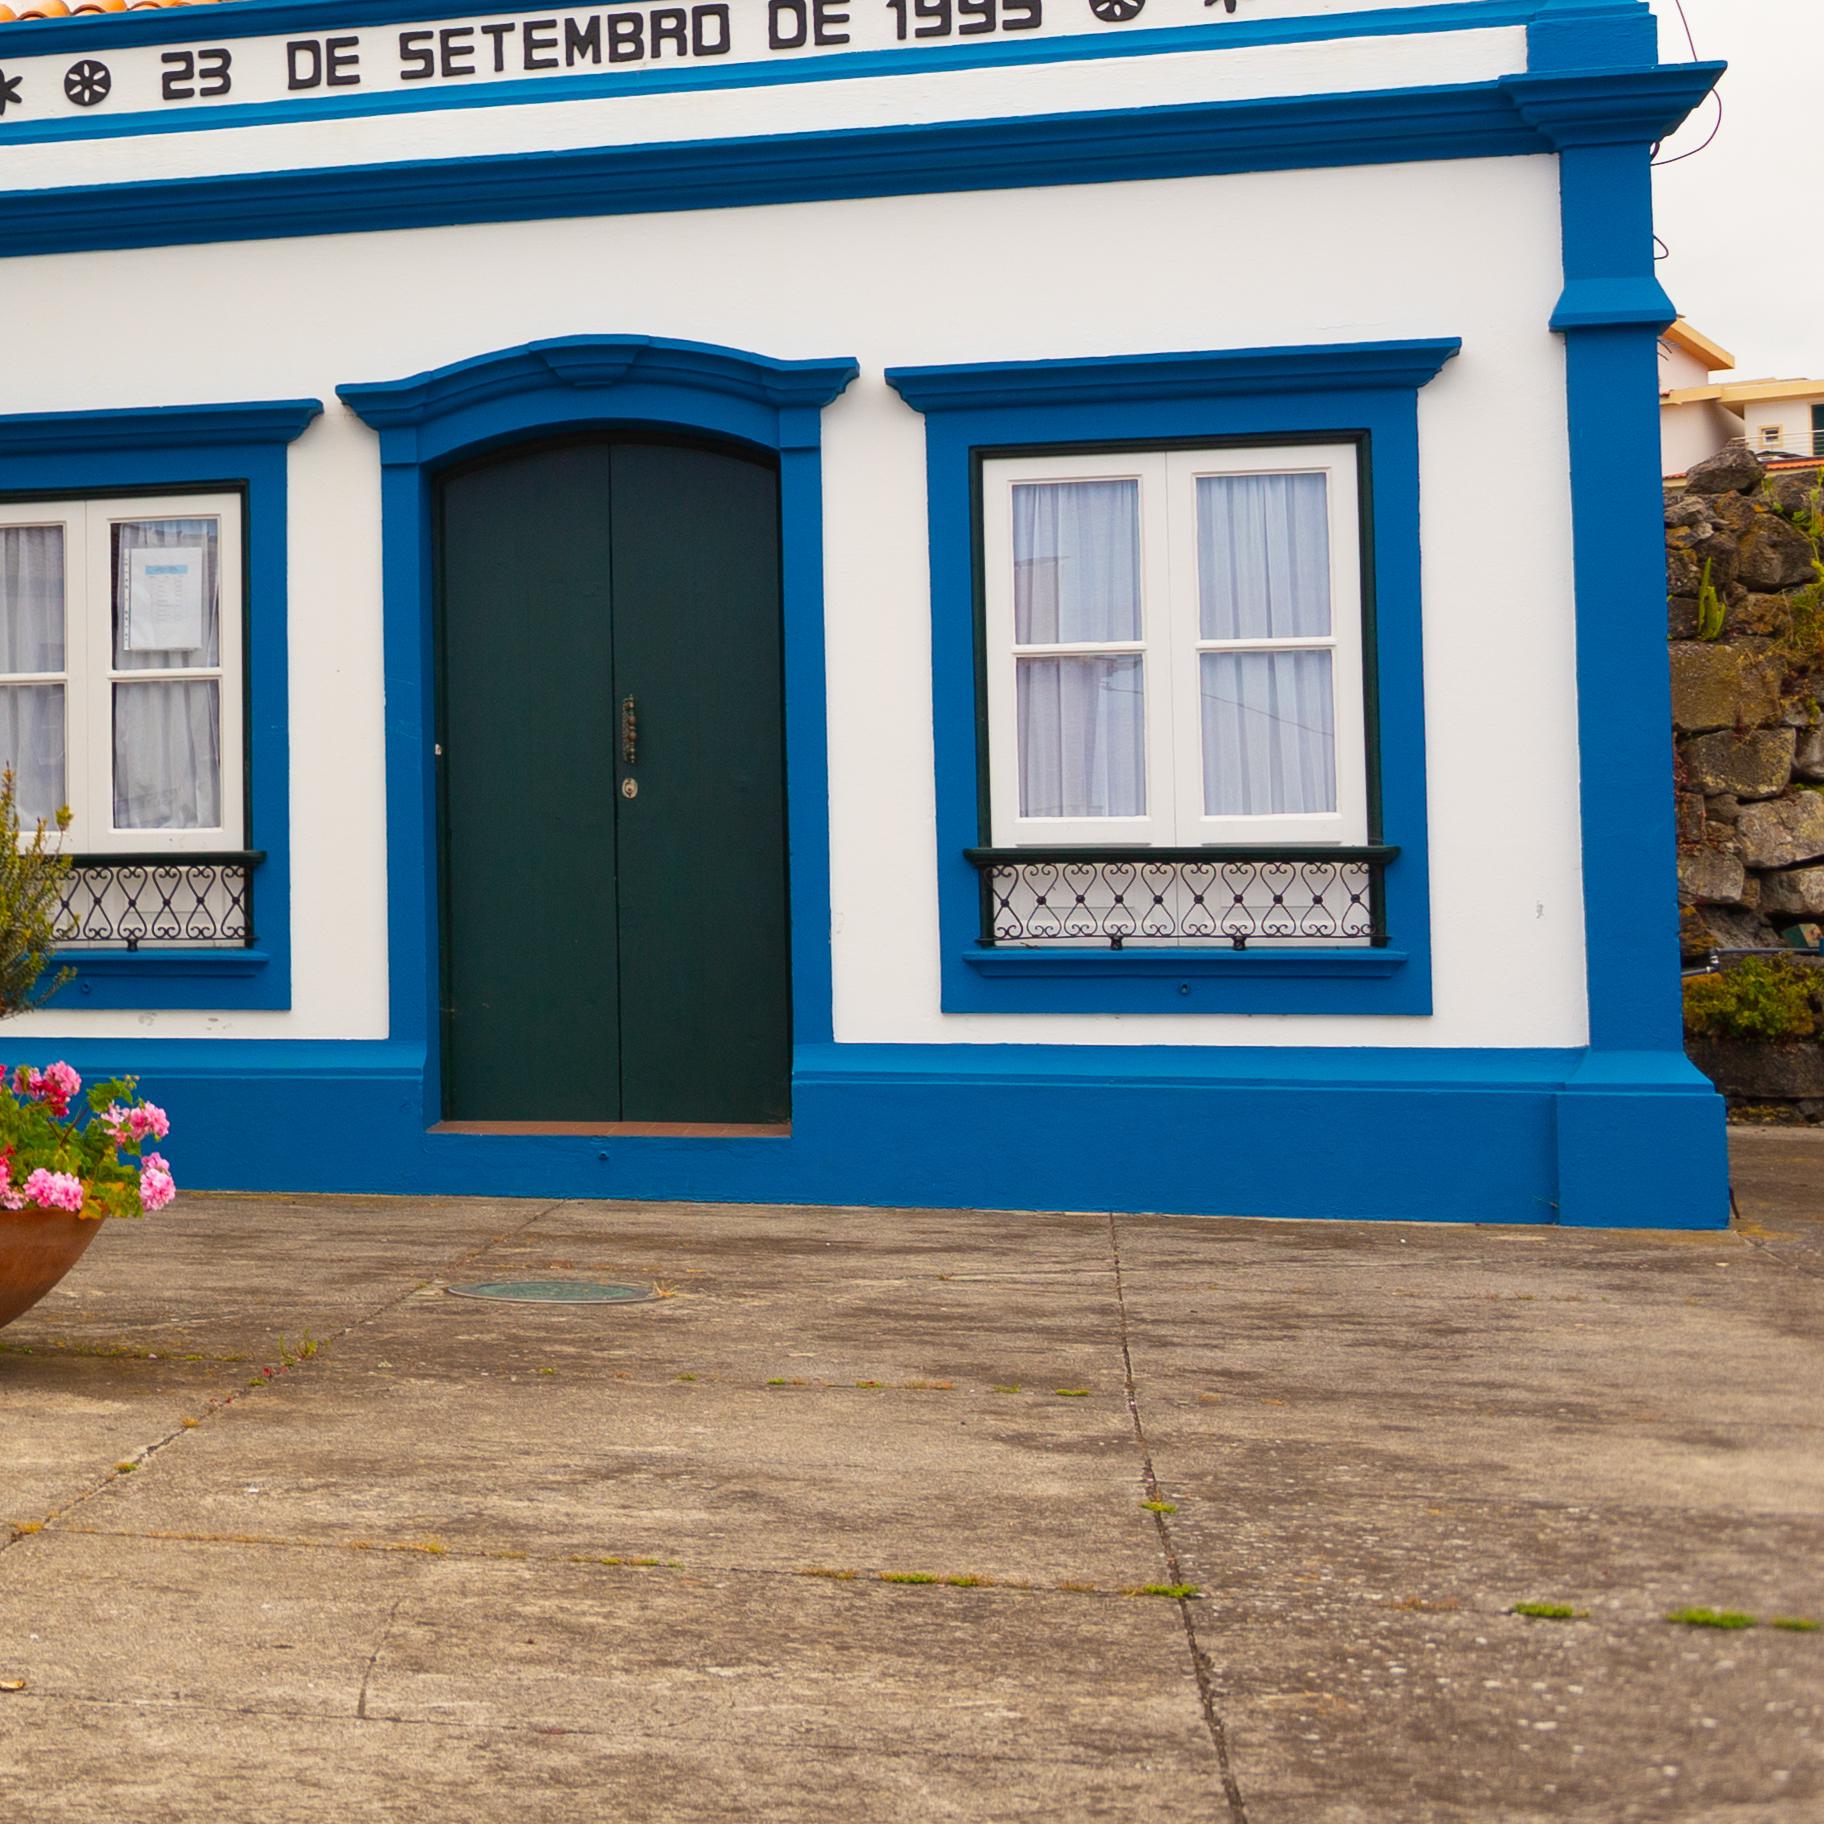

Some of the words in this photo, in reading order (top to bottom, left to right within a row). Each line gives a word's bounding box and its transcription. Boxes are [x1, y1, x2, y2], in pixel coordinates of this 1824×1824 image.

[161, 48, 232, 101] 23
[286, 36, 361, 91] DE
[399, 3, 731, 80] SETEMBRO
